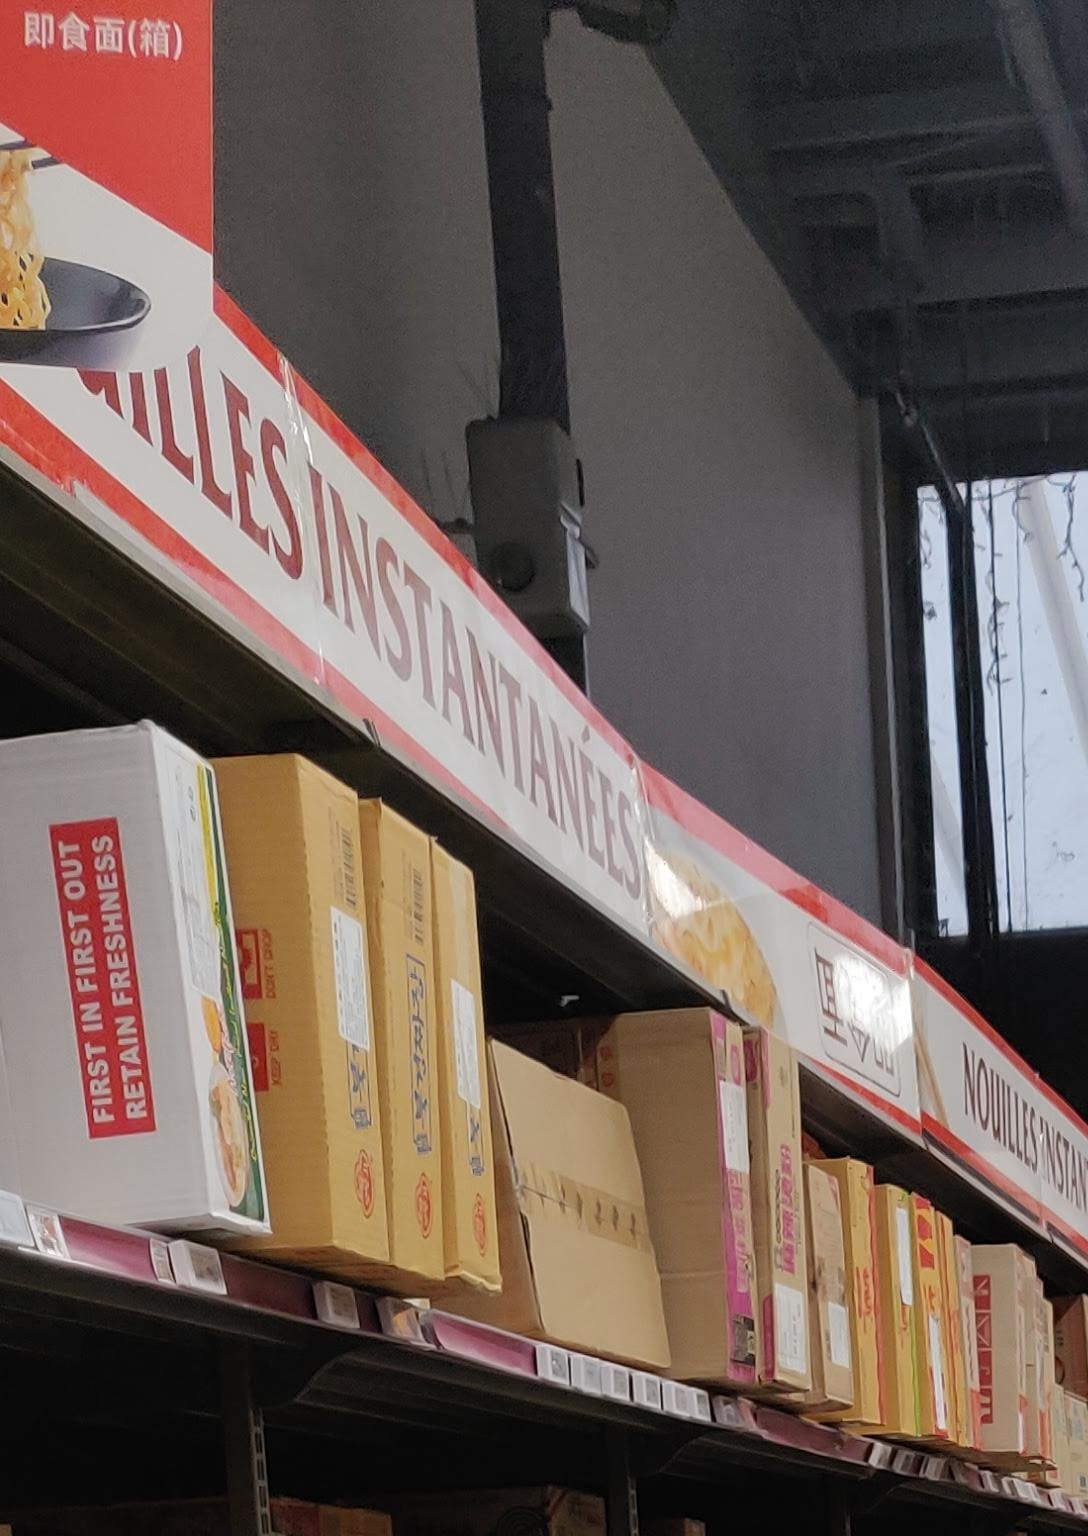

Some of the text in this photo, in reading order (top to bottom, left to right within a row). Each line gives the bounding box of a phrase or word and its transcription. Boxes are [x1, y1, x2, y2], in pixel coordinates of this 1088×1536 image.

[24, 11, 183, 61] 即食面(箱)
[308, 462, 643, 900] INSTANTANÉES
[58, 840, 115, 1123] FIRST IN FIRST OUT
[91, 834, 147, 1119] RETAIN FRESHNESS
[963, 1042, 1038, 1173] NOUILLES
